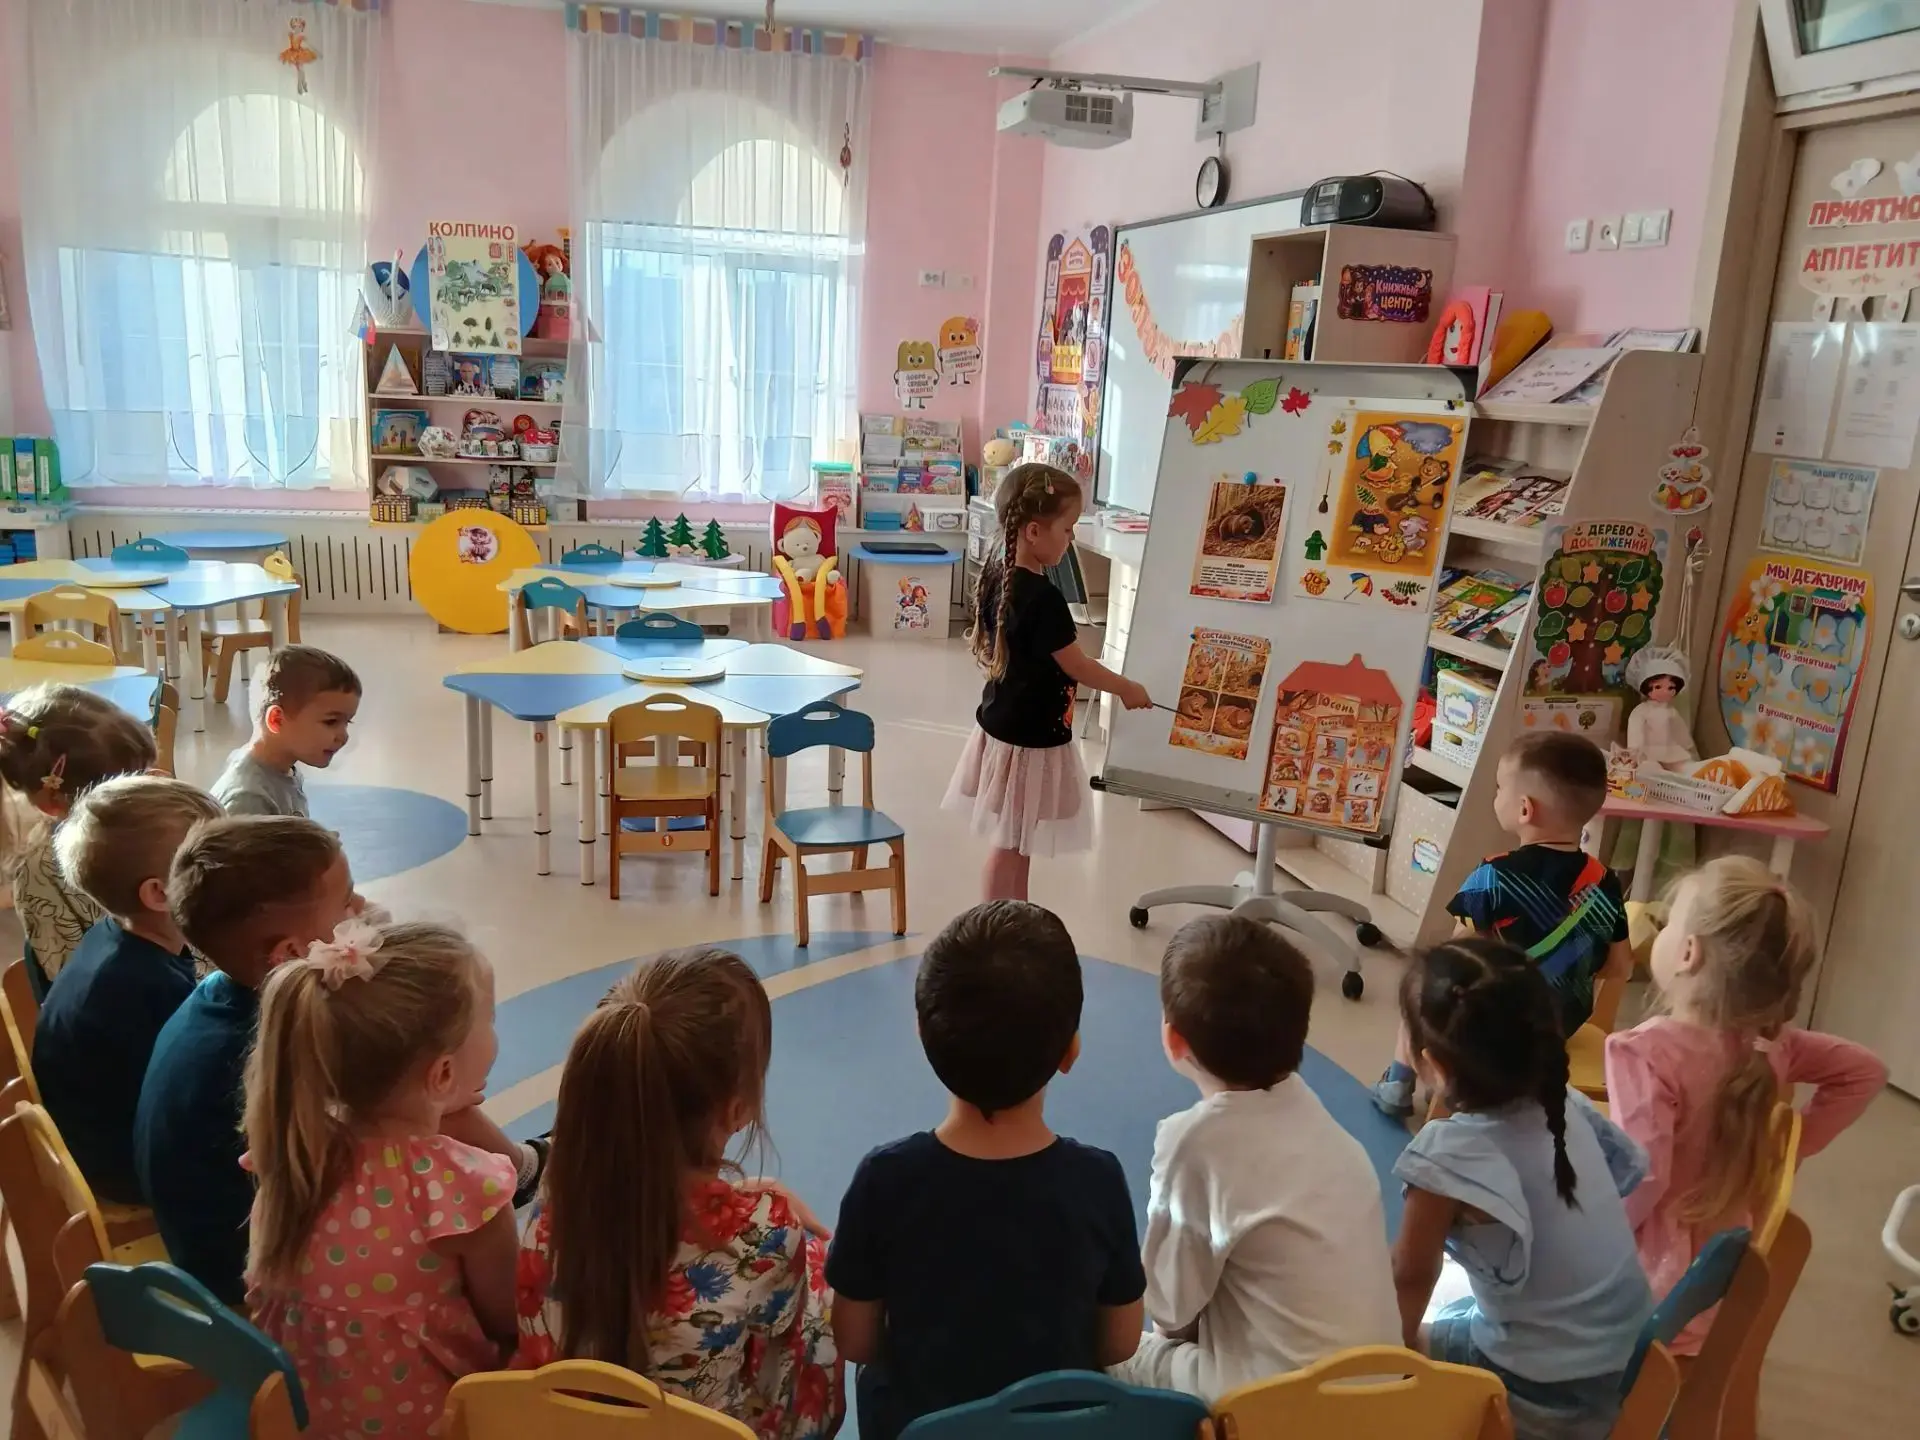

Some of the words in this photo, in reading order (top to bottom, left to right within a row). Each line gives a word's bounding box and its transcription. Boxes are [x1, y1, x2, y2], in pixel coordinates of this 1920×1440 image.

[1808, 195, 1920, 225] ПРИЯТНО
[429, 222, 514, 240] КОЛПИНО
[1803, 241, 1920, 272] АППЕТИТ
[1375, 279, 1419, 298] Книжный
[1380, 295, 1413, 312] центр
[1588, 524, 1634, 537] ДЕРЕВО
[1570, 537, 1648, 552] ДОСТИЖЕНИЙ
[1766, 563, 1789, 580] МЫ
[1792, 568, 1866, 593] ДЕЖУРИМ
[1320, 697, 1354, 714] Осень
